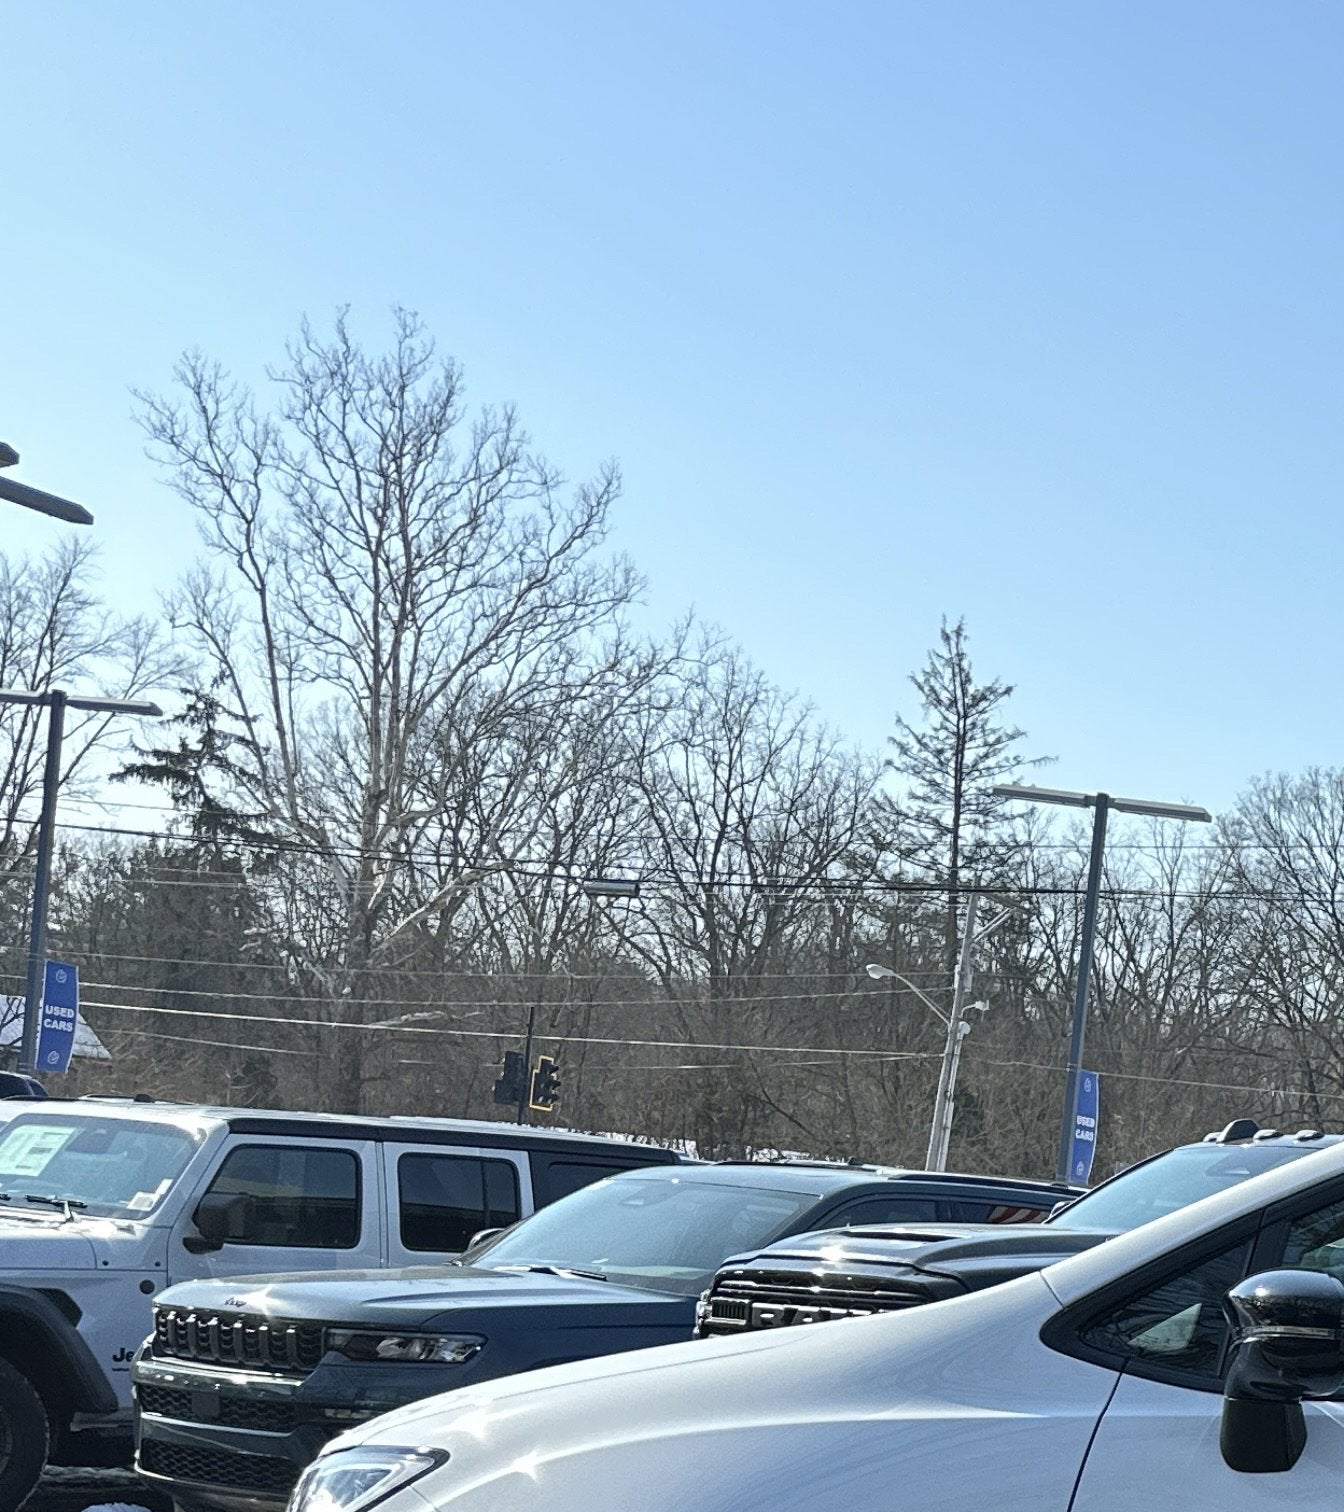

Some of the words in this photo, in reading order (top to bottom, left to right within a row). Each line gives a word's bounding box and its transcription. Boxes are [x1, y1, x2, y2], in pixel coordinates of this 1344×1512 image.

[45, 1004, 75, 1019] USED
[43, 1018, 74, 1032] CARS
[1077, 1115, 1095, 1128] USED
